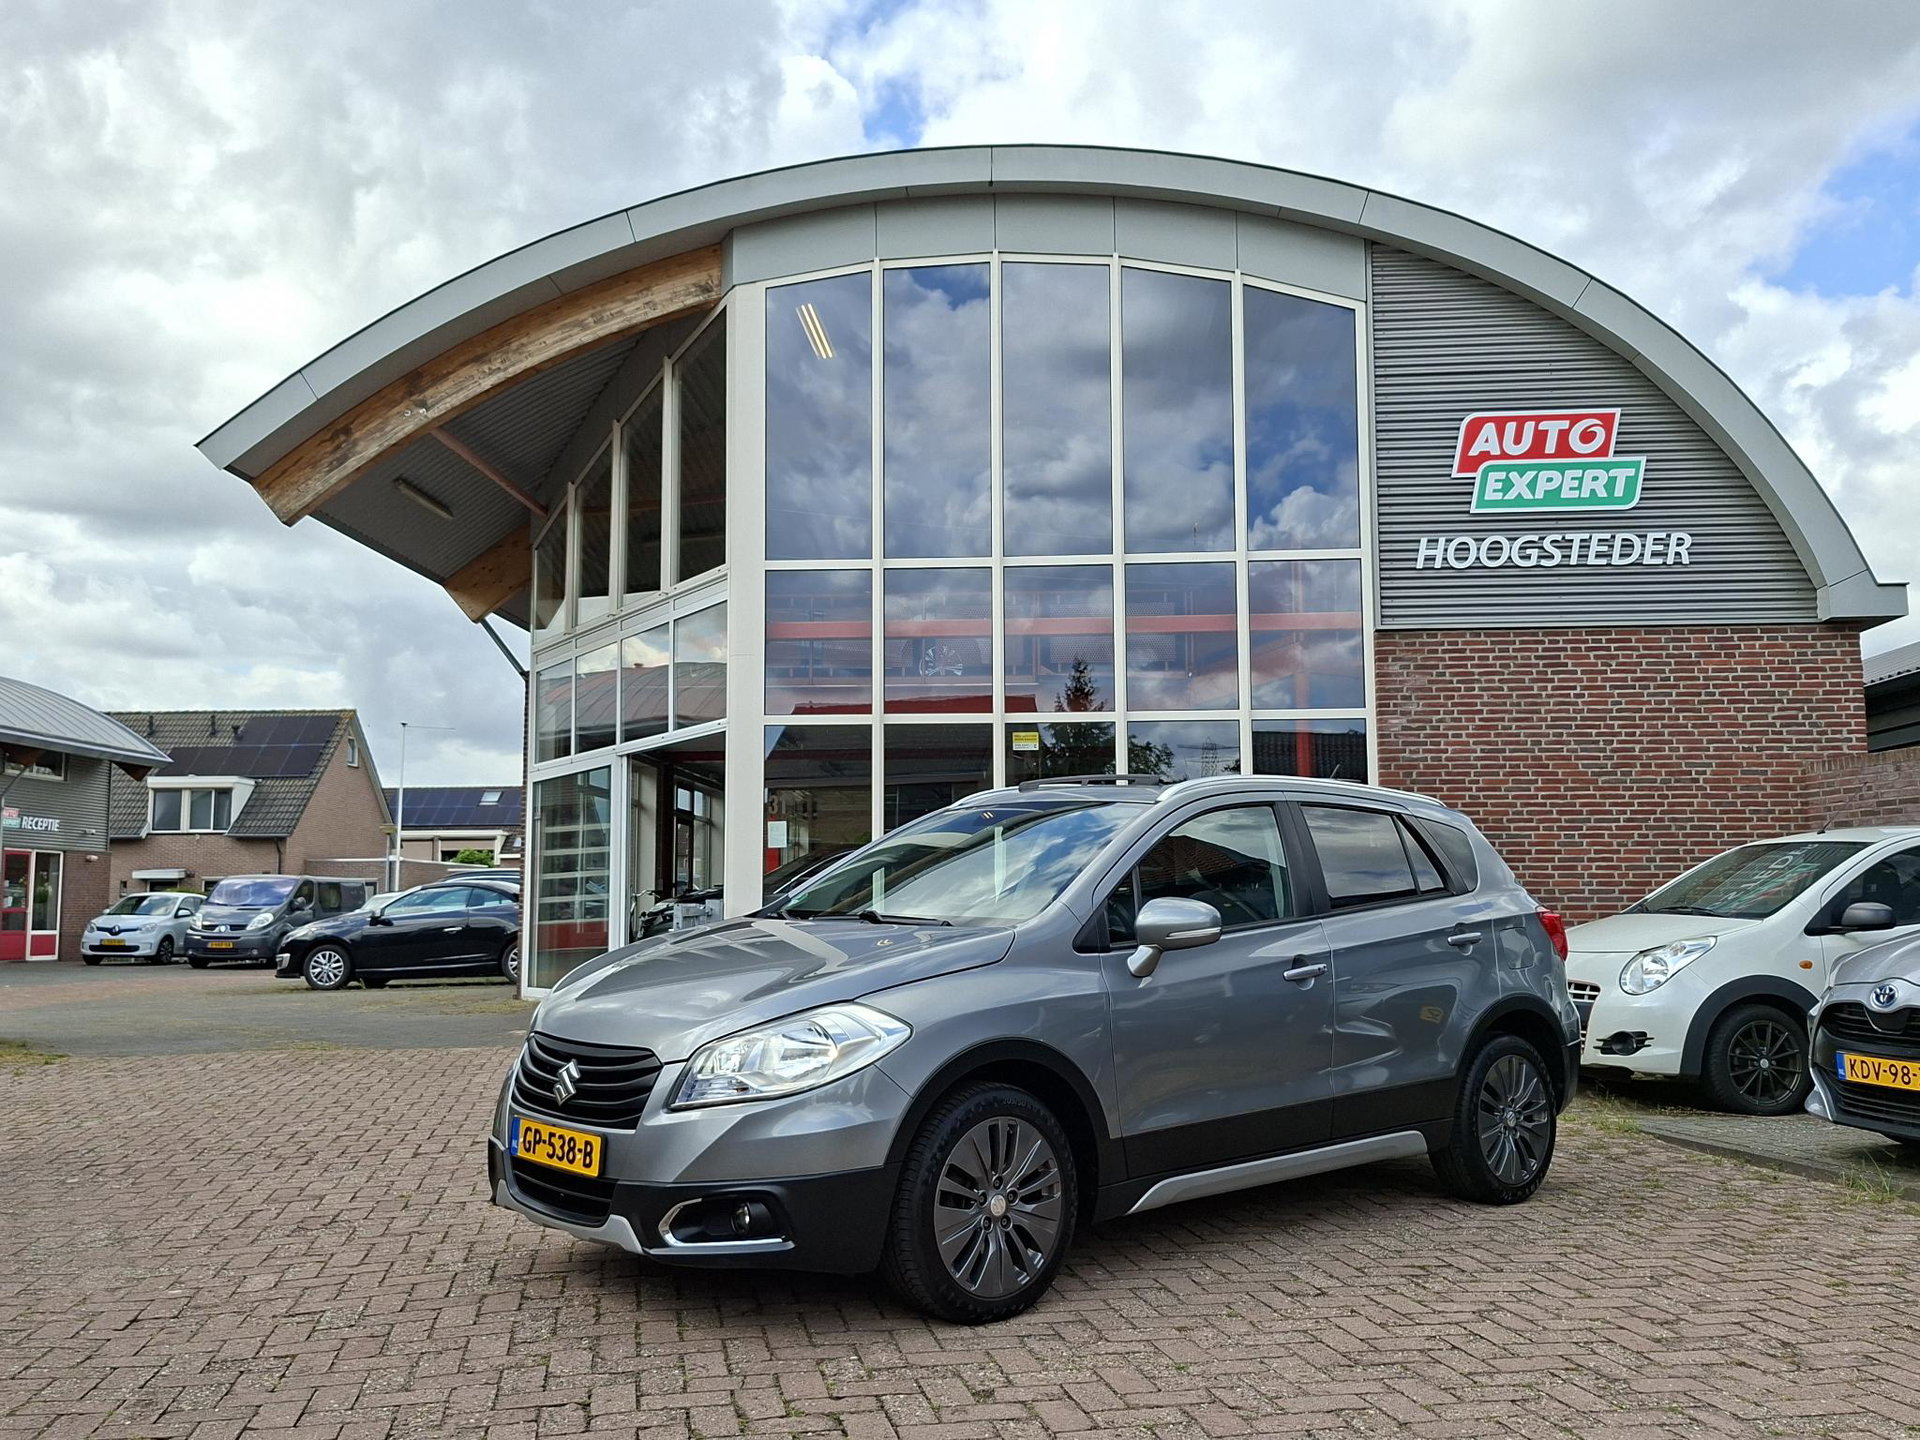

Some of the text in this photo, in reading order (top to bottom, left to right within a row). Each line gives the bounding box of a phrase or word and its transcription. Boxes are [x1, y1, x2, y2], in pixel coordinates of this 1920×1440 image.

[1467, 418, 1606, 457] AUTO
[1483, 468, 1635, 501] EXPERT
[1415, 532, 1693, 570] HOOGSTEDER
[22, 816, 60, 831] RECEPTIE
[1849, 1059, 1920, 1085] KDV-98-
[523, 1126, 594, 1168] GP-538-B
